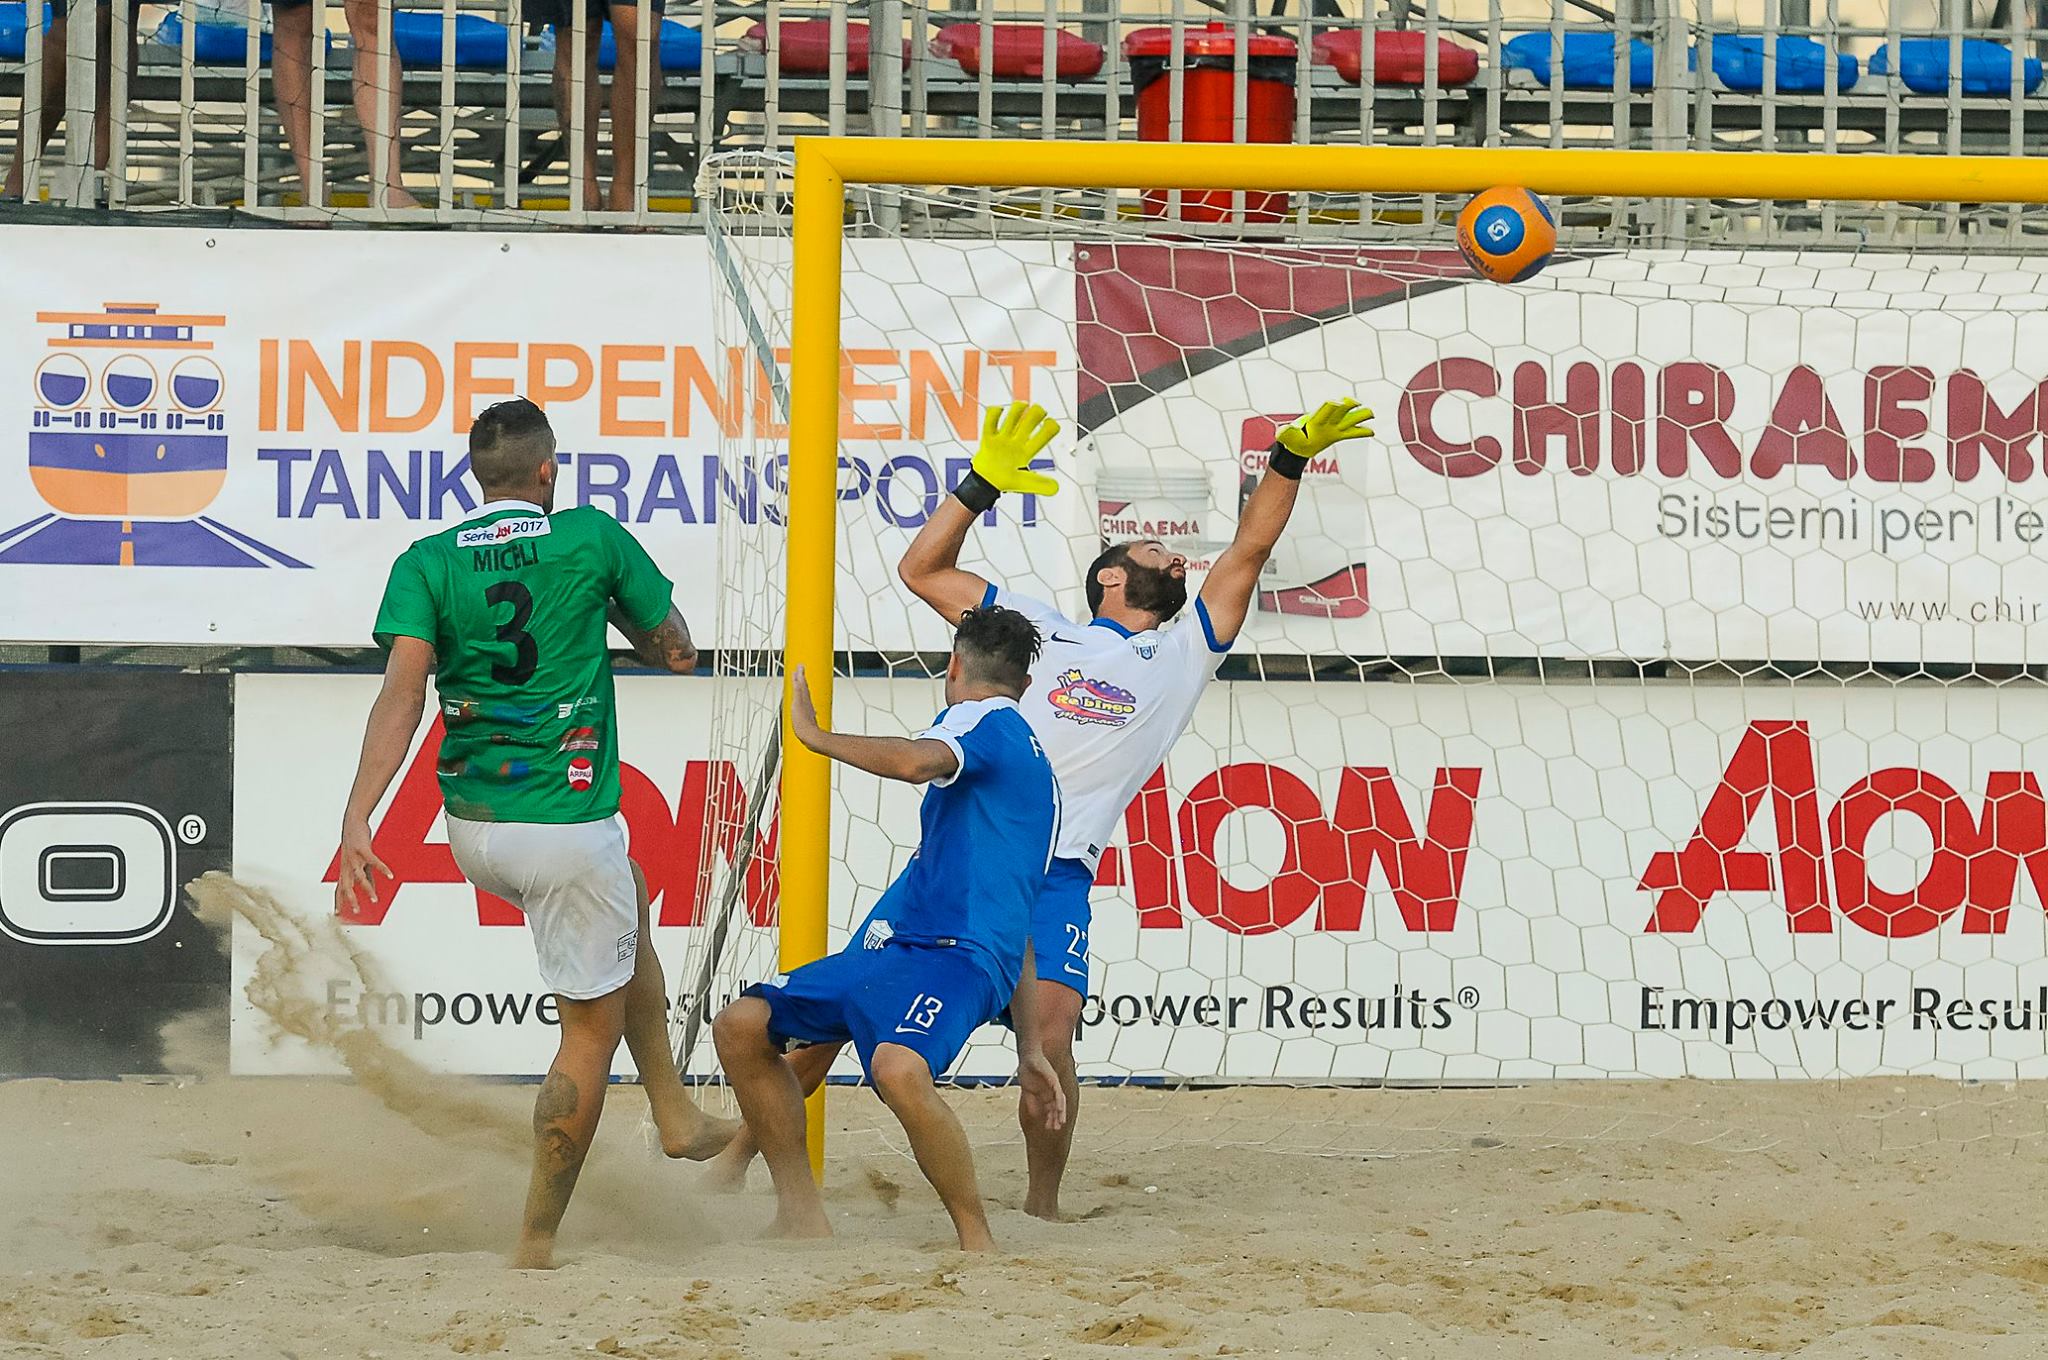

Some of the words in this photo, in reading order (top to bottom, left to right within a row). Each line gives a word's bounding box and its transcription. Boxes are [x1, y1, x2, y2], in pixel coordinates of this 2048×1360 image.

[462, 530, 495, 542] Serie
[512, 521, 543, 533] 2017
[1101, 518, 1201, 536] CHIRAEMA
[1656, 494, 1859, 541] Sistemi
[1880, 505, 1975, 554] per
[484, 581, 540, 686] 3
[1083, 696, 1136, 714] bingo
[905, 993, 944, 1030] 13
[1640, 986, 1897, 1045] Empower
